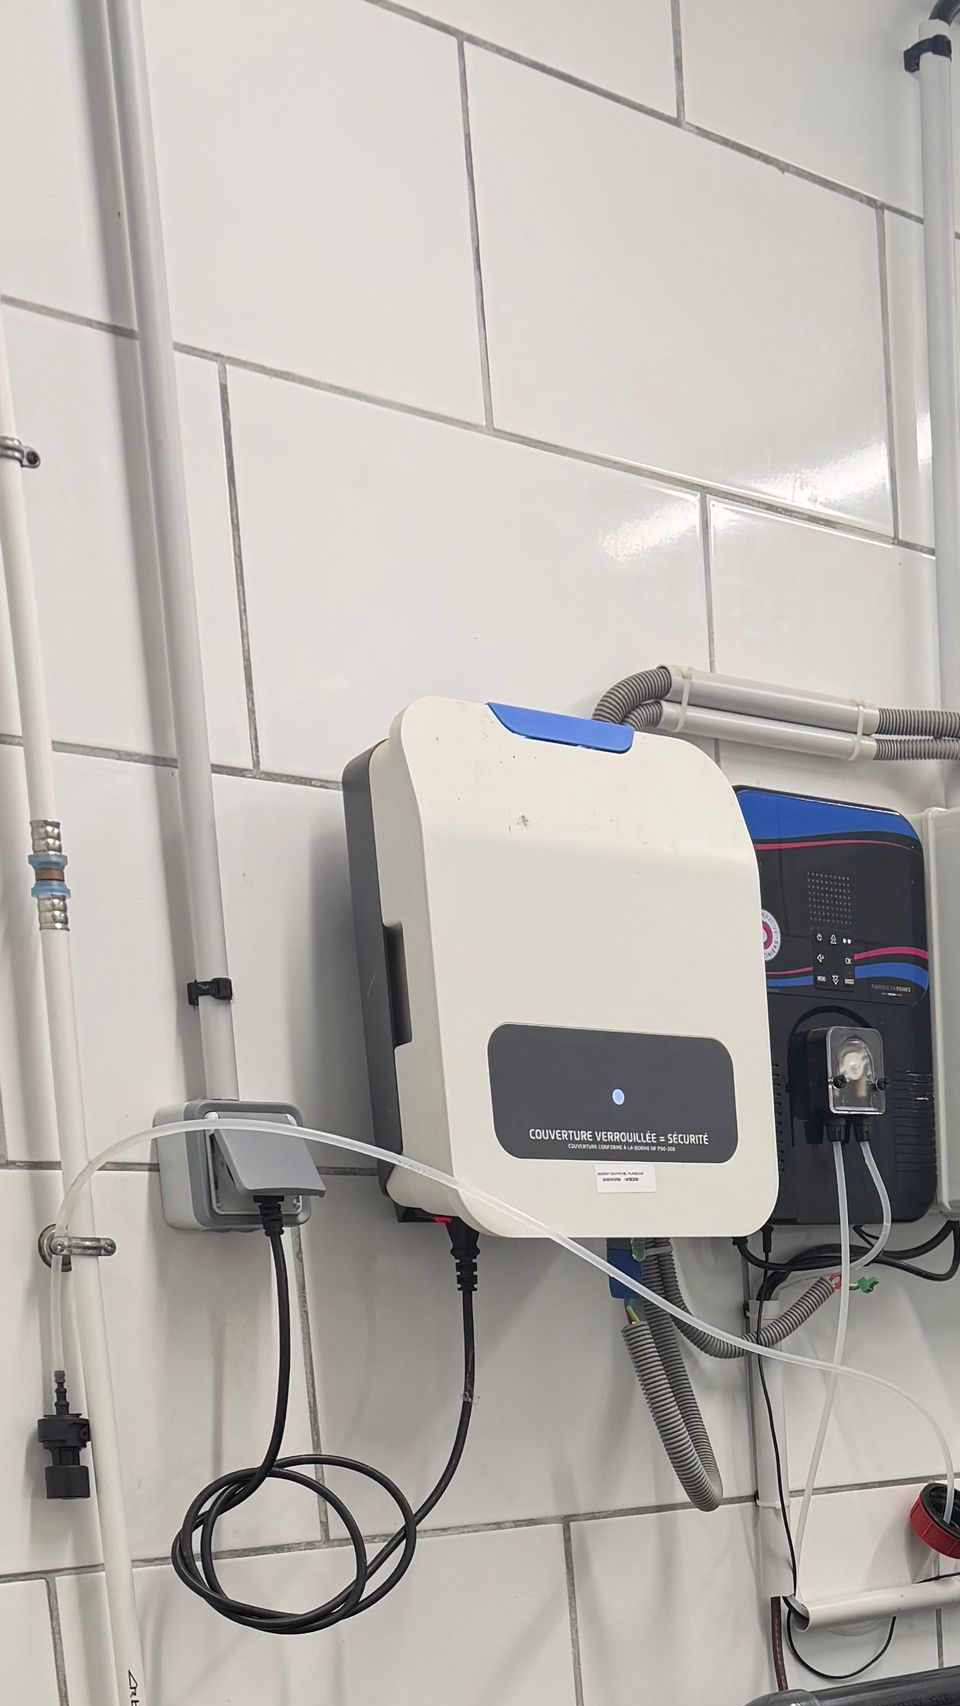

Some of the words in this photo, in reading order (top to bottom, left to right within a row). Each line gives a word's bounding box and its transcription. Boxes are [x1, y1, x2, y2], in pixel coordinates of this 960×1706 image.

[529, 1128, 593, 1142] COUVERTURE
[595, 1130, 657, 1144] VERROUILLÉE
[667, 1131, 709, 1145] SÉCURITÉ
